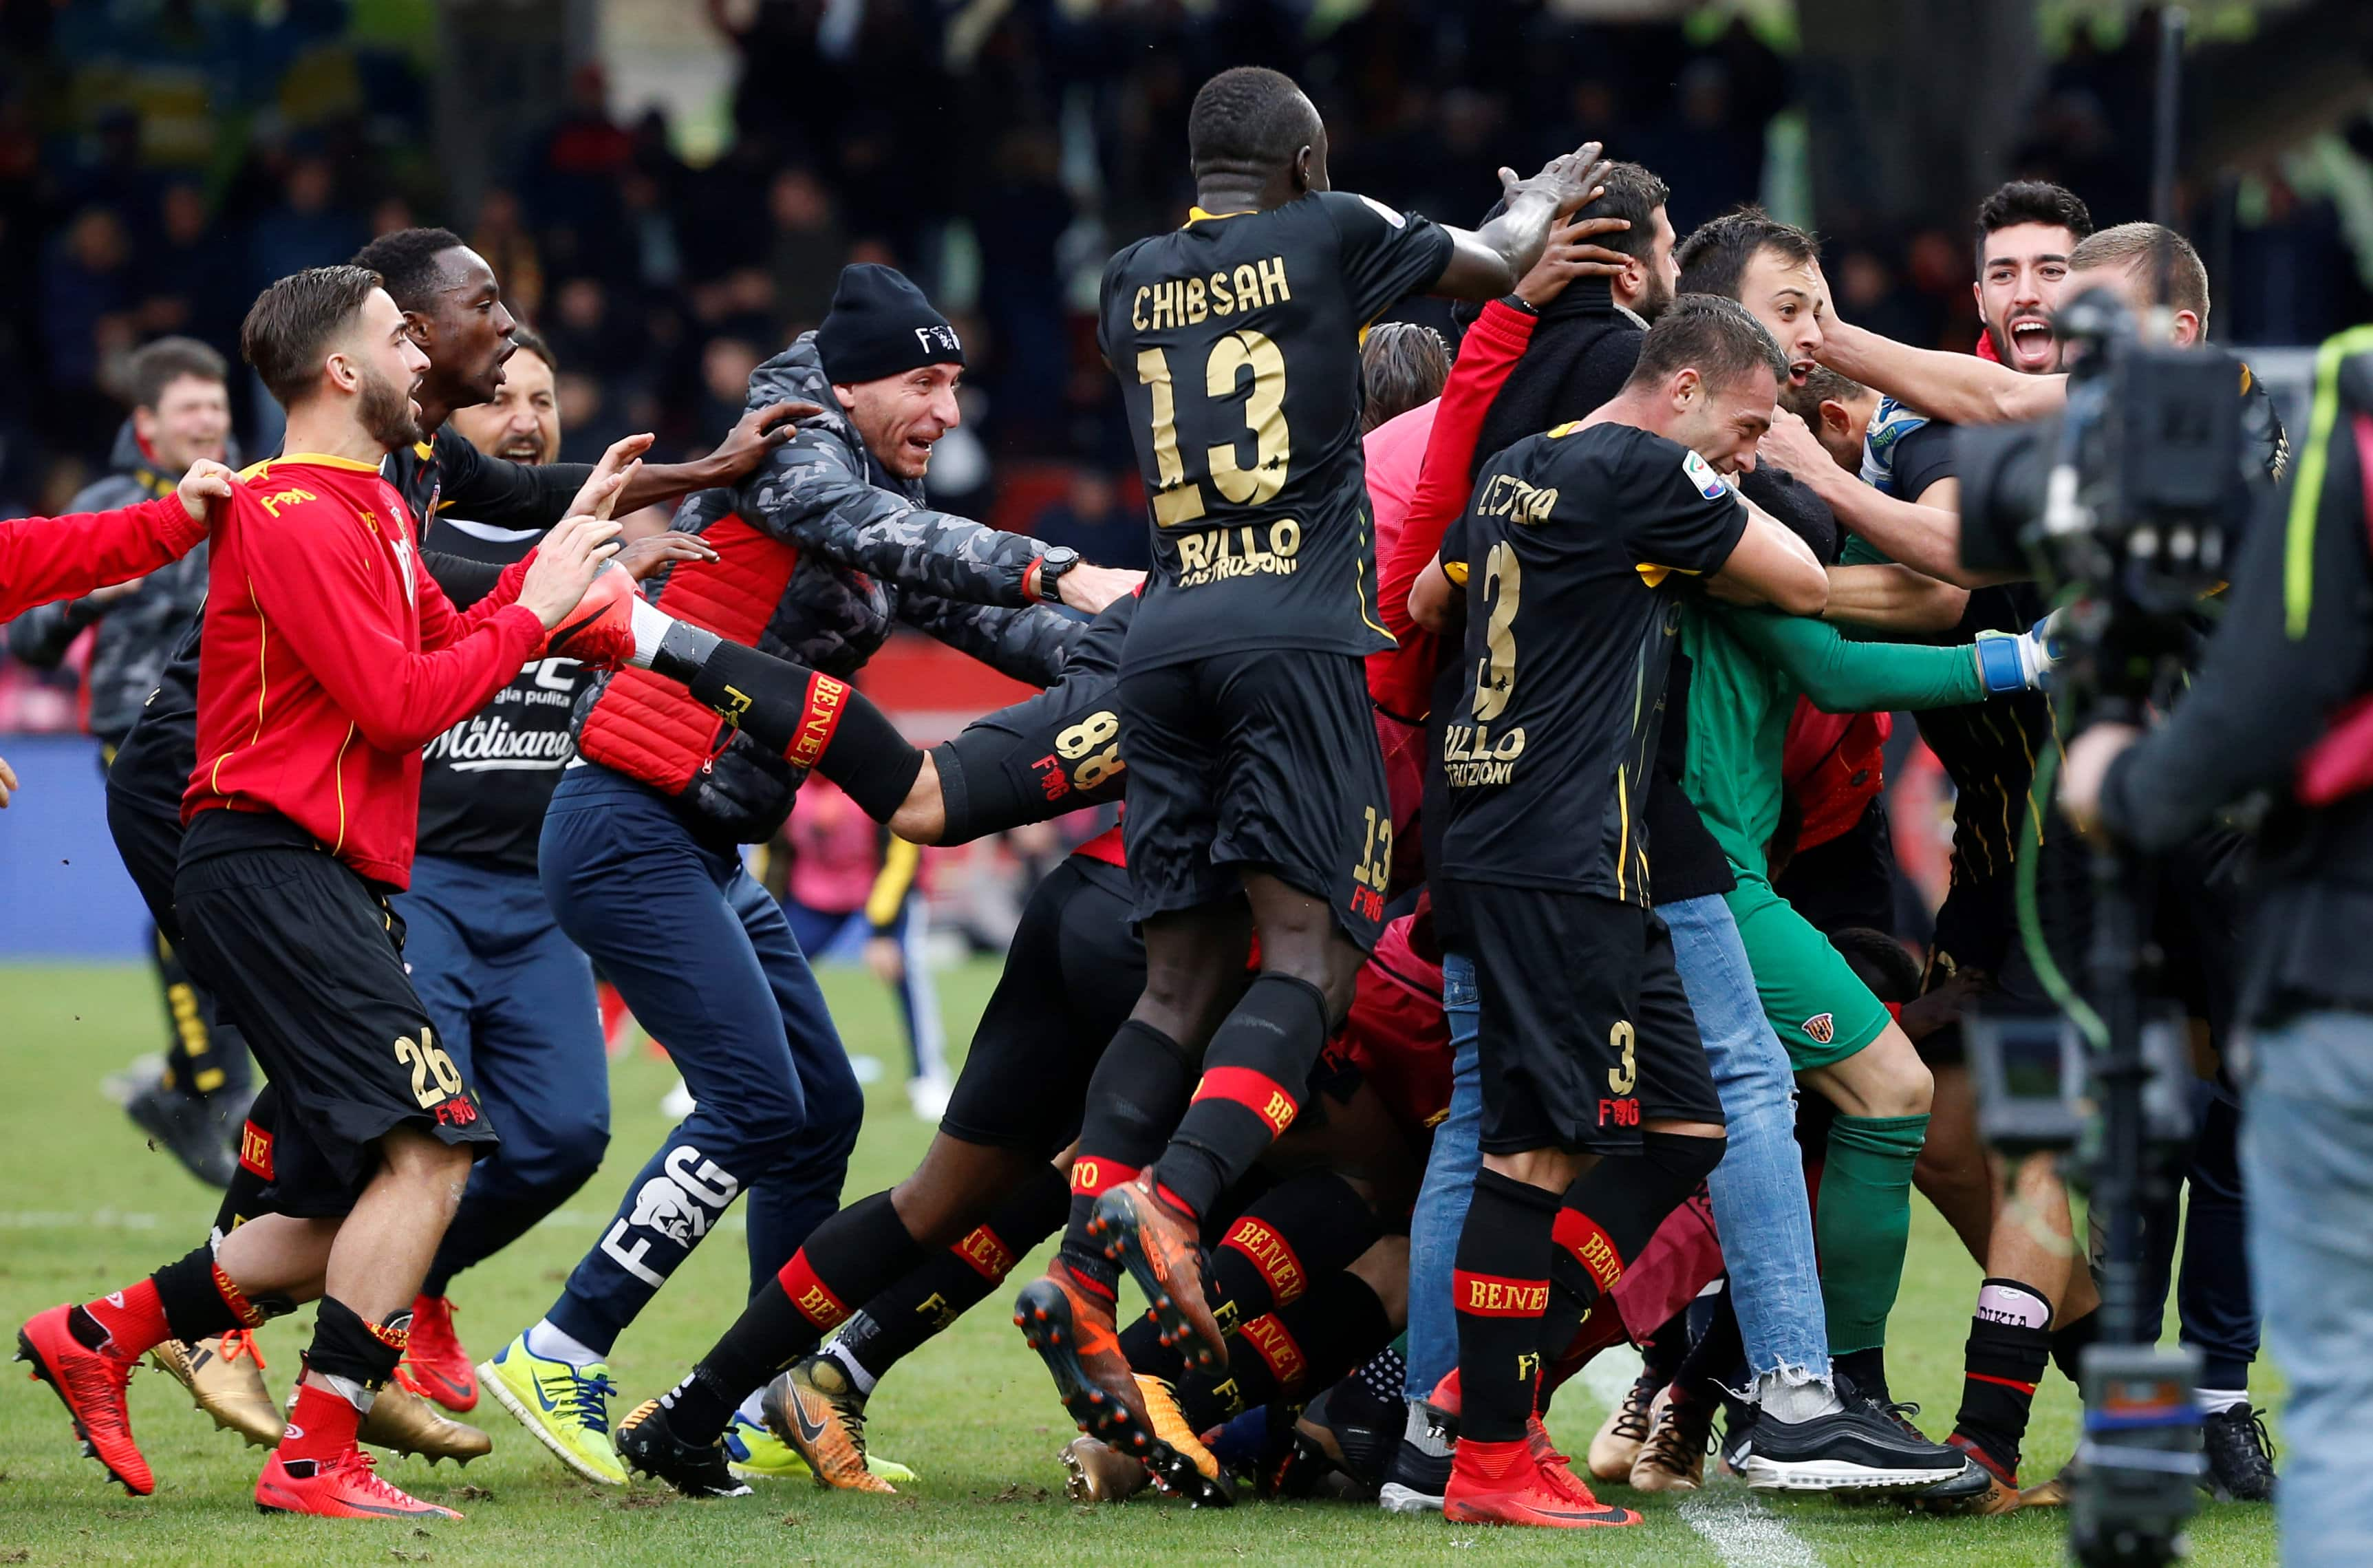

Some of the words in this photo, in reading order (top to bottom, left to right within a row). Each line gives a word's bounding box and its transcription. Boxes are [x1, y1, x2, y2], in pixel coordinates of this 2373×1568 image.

[1132, 255, 1292, 331] CHIBSAH
[1137, 330, 1291, 528] 13
[1177, 517, 1301, 575] RILLO
[1471, 539, 1521, 722] 3
[524, 690, 571, 708] pulita
[422, 716, 575, 761] Molisana
[1055, 710, 1126, 791] 88
[1353, 805, 1393, 892] 13
[394, 1026, 463, 1110] 26
[1608, 1020, 1637, 1096] 3
